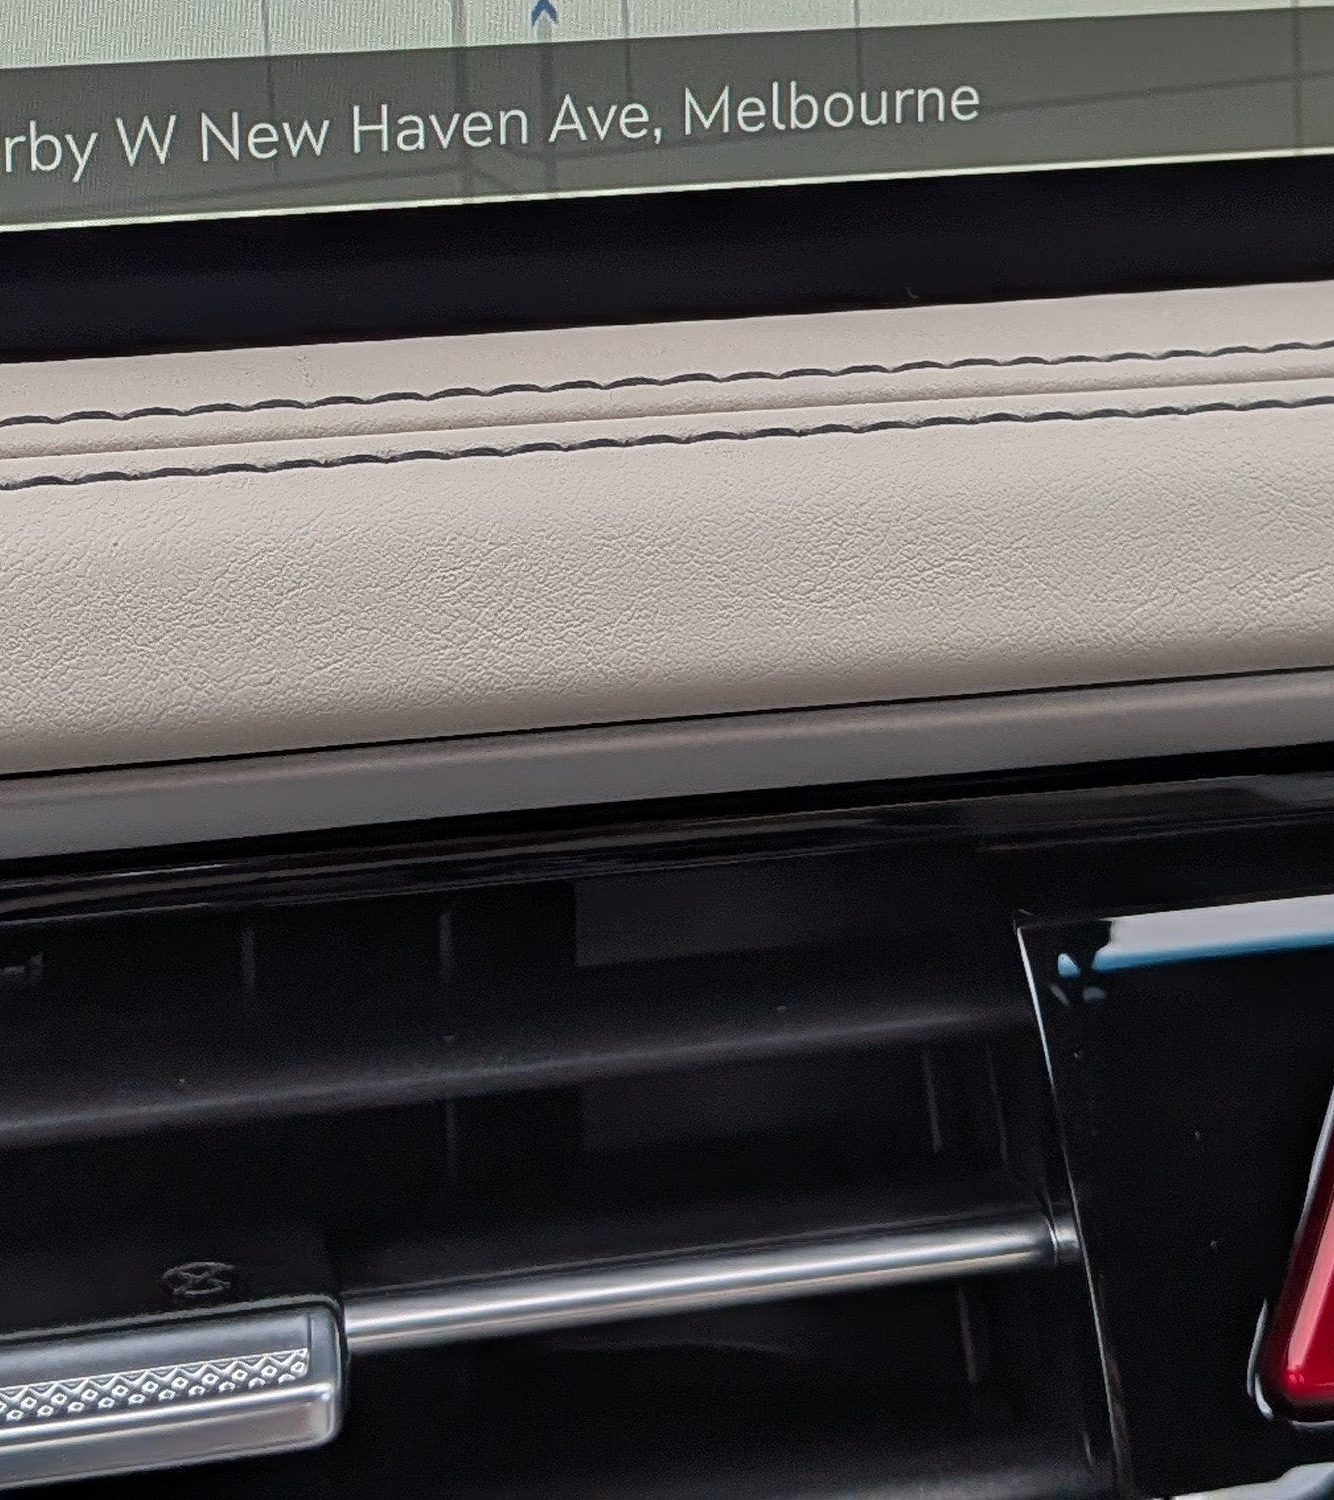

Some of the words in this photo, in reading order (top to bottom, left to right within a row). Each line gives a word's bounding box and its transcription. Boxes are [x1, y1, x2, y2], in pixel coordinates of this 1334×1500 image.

[115, 113, 178, 168] W
[200, 110, 331, 163] New
[352, 103, 530, 154] Haven
[547, 93, 664, 145] Ave,
[683, 79, 981, 137] Melbourne
